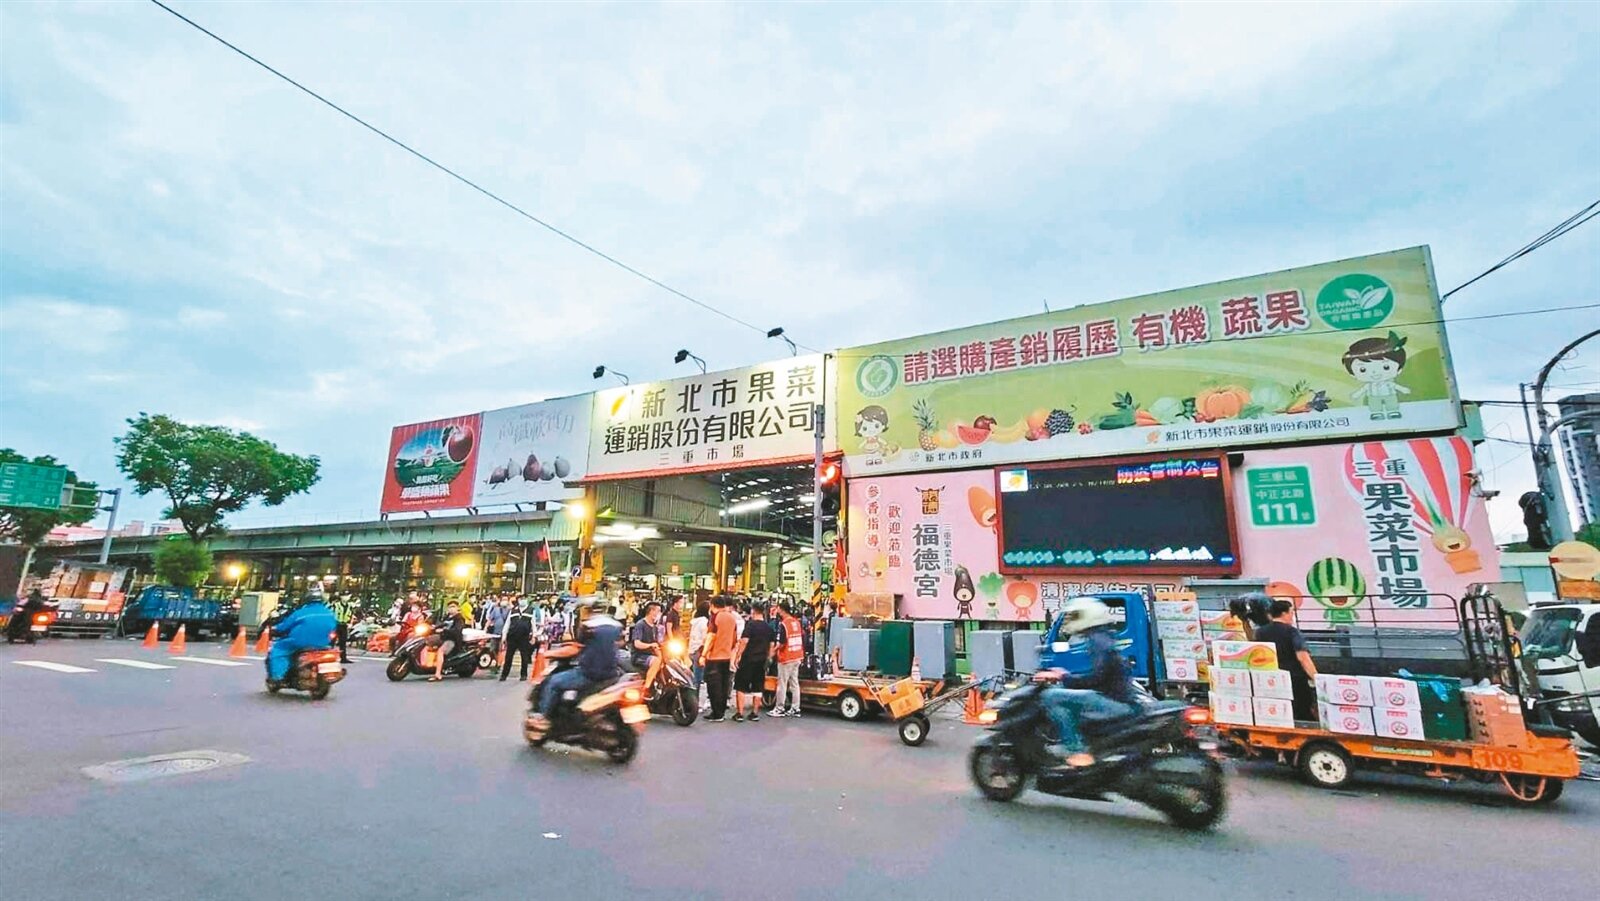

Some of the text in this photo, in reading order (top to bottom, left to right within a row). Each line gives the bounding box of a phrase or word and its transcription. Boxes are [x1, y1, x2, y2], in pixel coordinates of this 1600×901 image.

[904, 320, 1118, 383] 請選購產銷履歷
[1132, 305, 1207, 348] 有機
[1221, 290, 1306, 336] 蔬果
[641, 365, 816, 419] 新北市果菜
[604, 401, 815, 455] 運銷股份有限公司
[659, 444, 744, 465] 三重市場
[925, 448, 982, 463] 新北市政府
[1117, 458, 1219, 484] 防疫管制公告
[1354, 458, 1409, 477] 三重
[1255, 488, 1304, 500] 中正北路
[888, 505, 901, 568] 歡迎蒞臨
[1364, 482, 1428, 608] 果菜市場
[912, 522, 941, 598] 福德宮
[1481, 751, 1523, 769] 109
